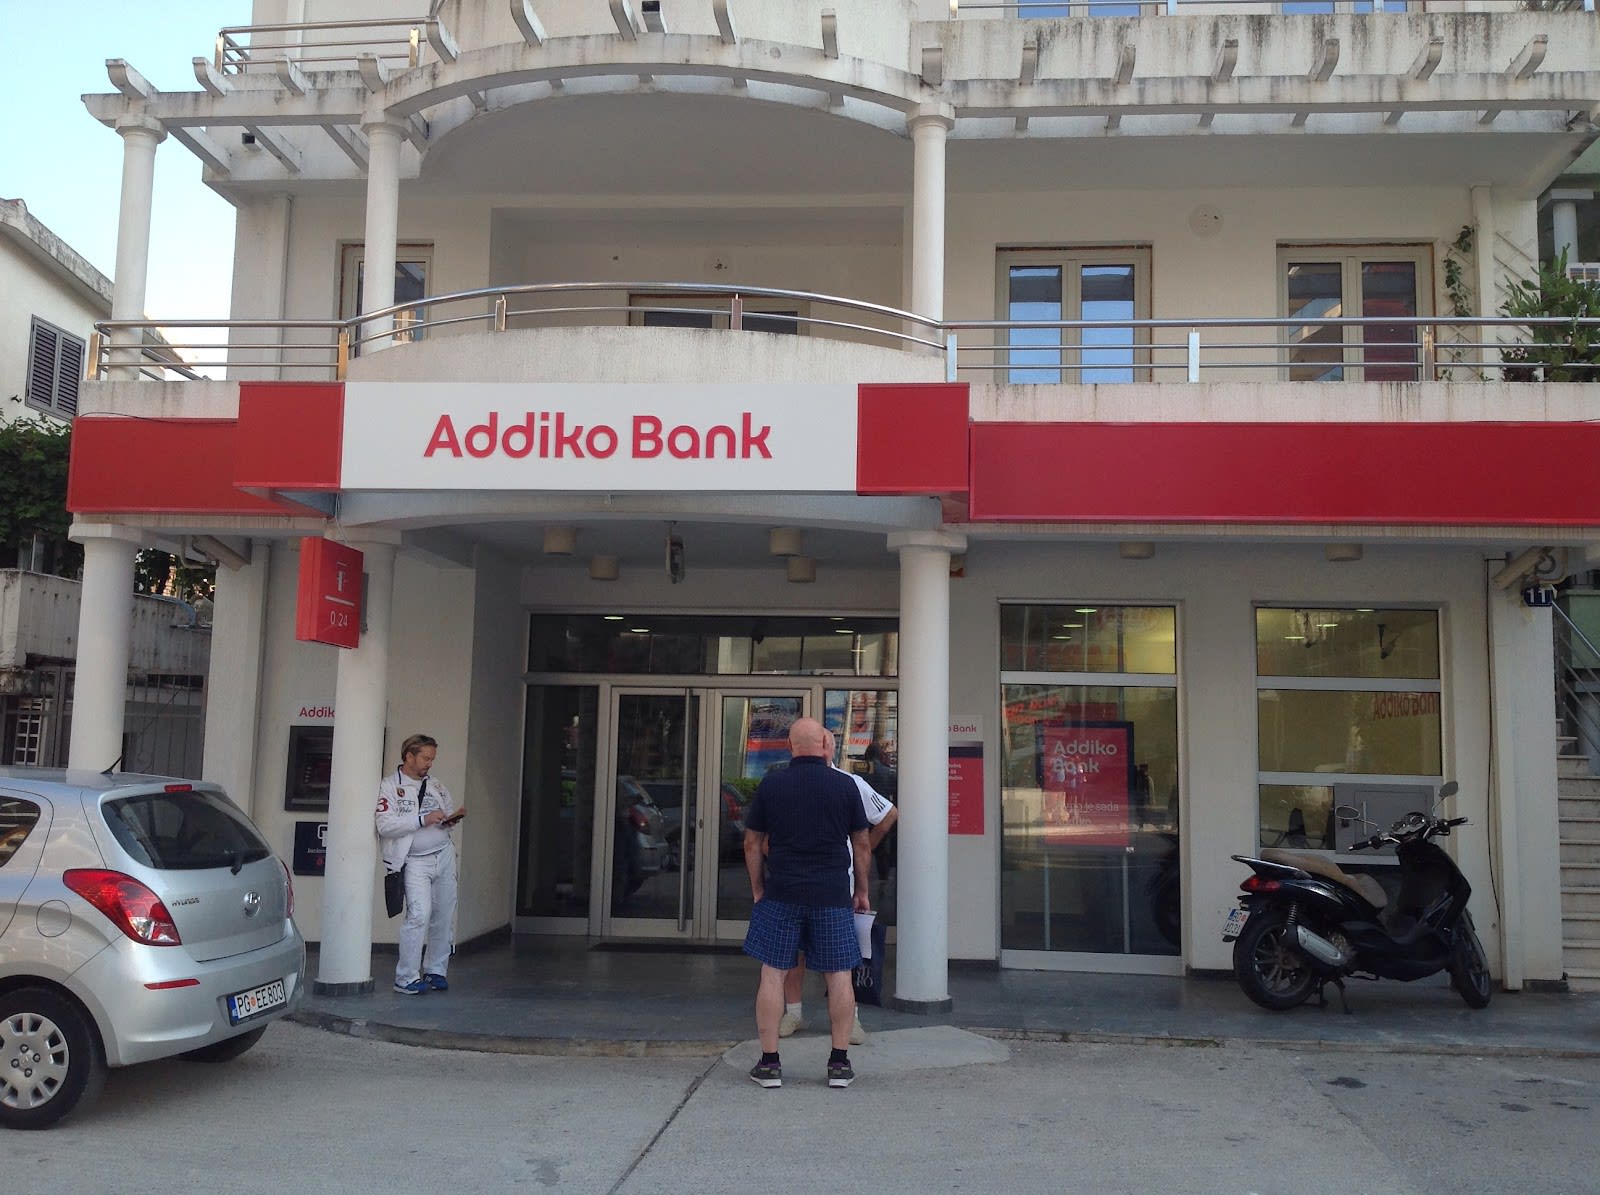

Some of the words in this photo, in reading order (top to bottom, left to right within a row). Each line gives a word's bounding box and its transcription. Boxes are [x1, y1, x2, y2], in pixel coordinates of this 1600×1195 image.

[423, 411, 618, 459] Addiko
[632, 412, 773, 459] Bank
[1527, 588, 1547, 603] 11
[1412, 692, 1438, 717] Ban
[953, 725, 977, 733] Bank
[1053, 740, 1118, 756] Addiko
[1052, 757, 1100, 773] Bank
[375, 797, 389, 813] 3
[237, 994, 251, 1015] PG
